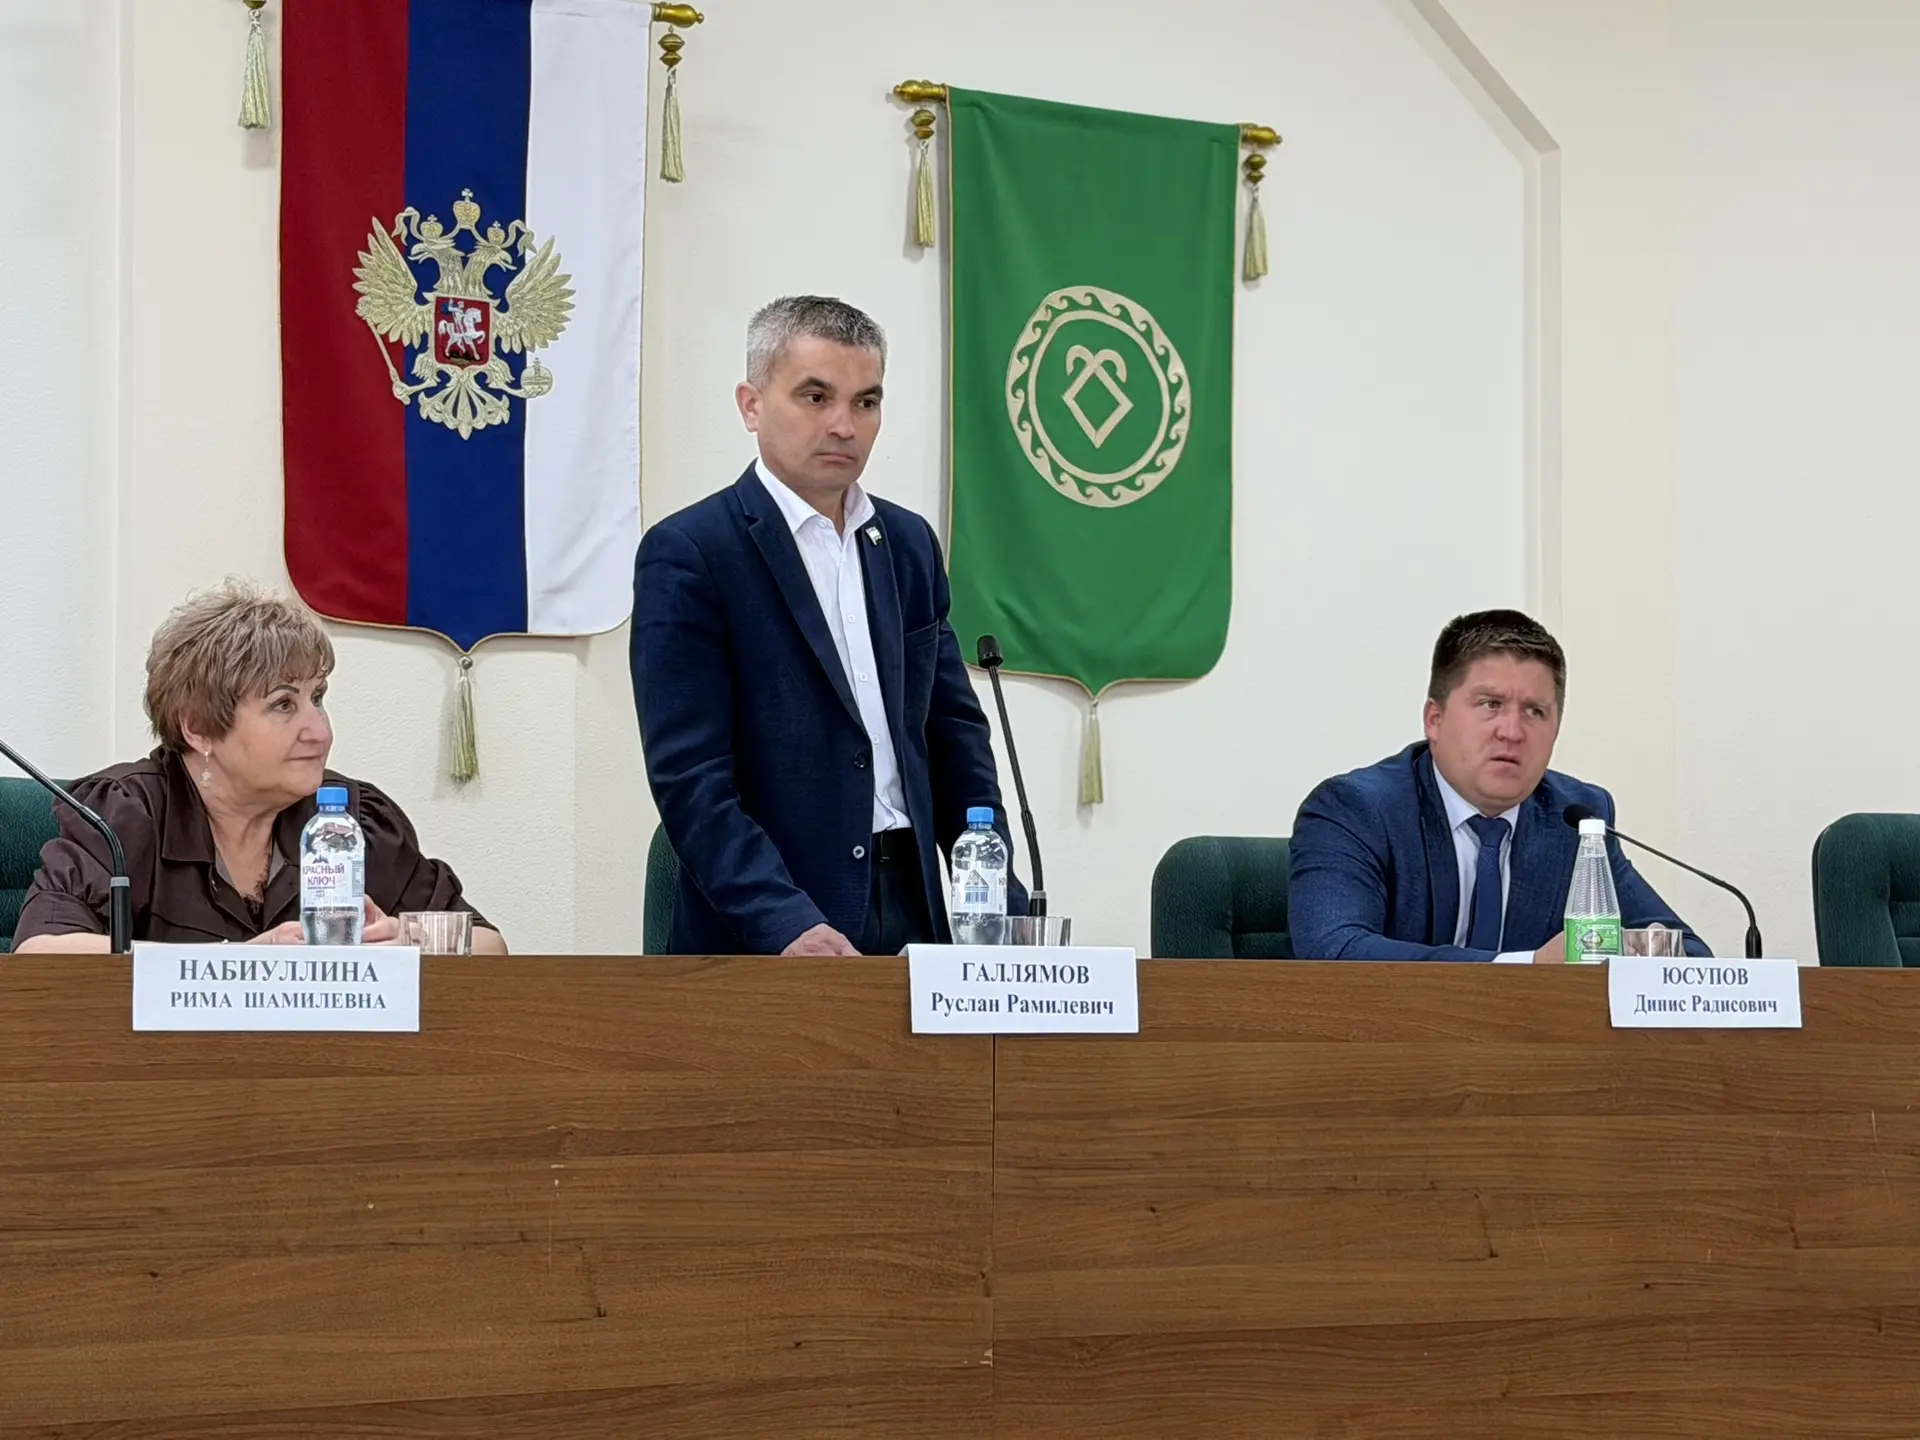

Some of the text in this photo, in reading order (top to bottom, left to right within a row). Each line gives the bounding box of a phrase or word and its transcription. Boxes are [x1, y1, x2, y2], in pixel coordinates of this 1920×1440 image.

[307, 876, 336, 886] КЛЮЧ
[179, 959, 379, 982] НАБИУЛЛИНА
[962, 962, 1090, 984] ГАЛЛЯМОВ
[1662, 966, 1749, 985] ЮСУПОВ
[170, 991, 387, 1009] РИМА ШАМИЛЕВНА
[931, 992, 1114, 1017] Руслан Рамилевич
[1634, 994, 1778, 1015] Динис Радисович
